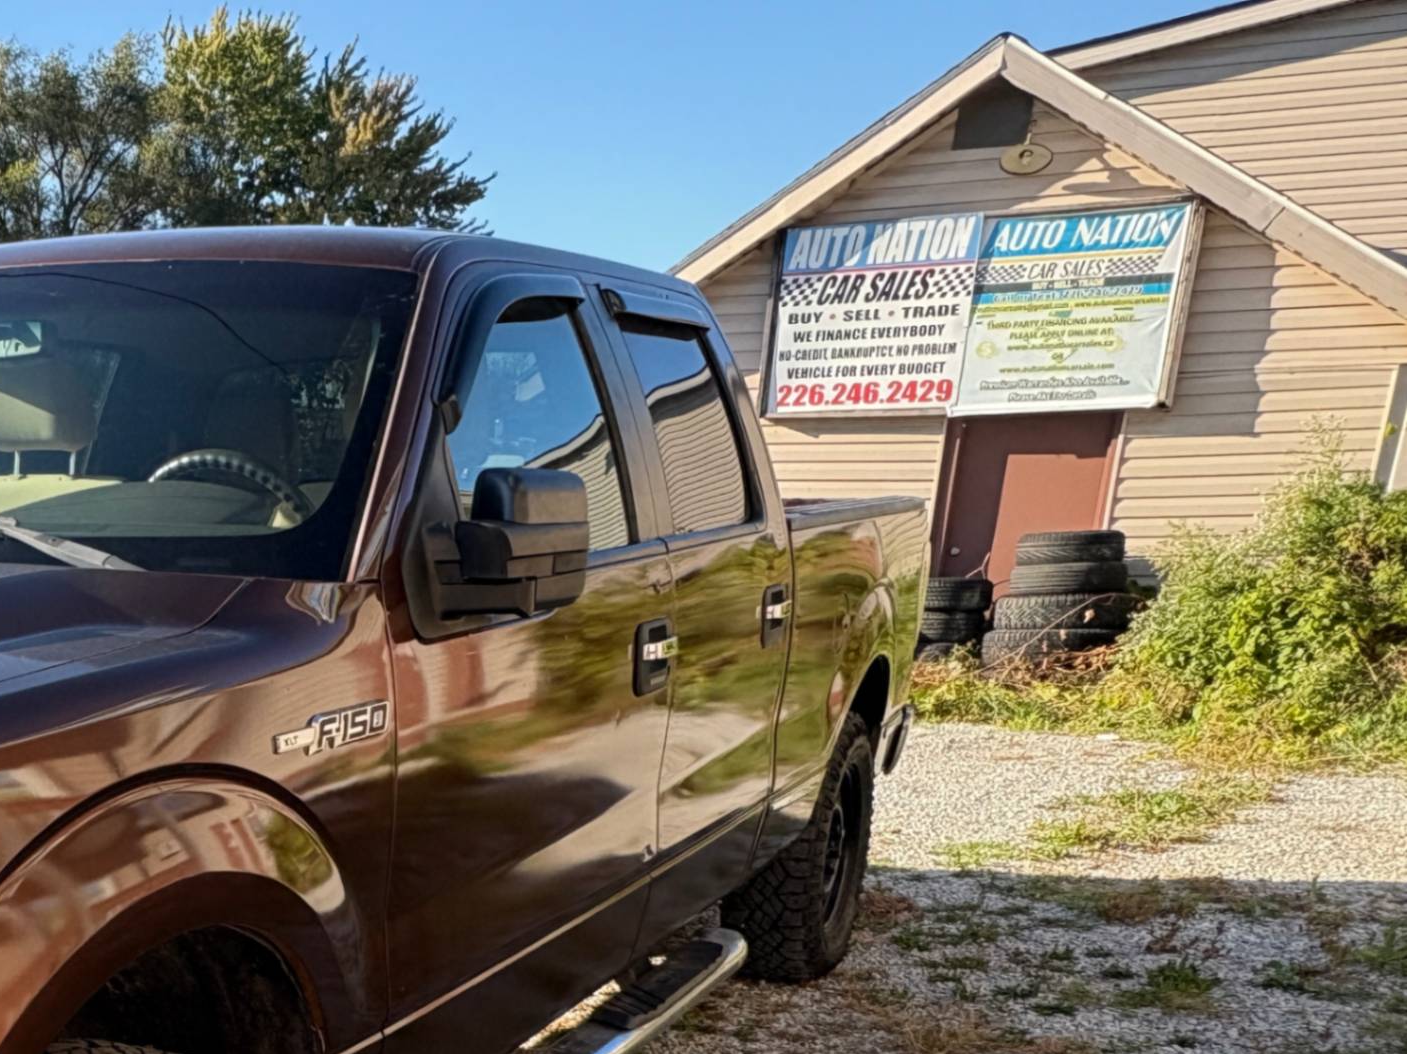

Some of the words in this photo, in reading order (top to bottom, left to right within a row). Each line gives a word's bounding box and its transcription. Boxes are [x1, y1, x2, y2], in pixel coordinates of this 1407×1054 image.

[994, 219, 1067, 252] AUTO
[1071, 211, 1180, 247] NATION
[788, 225, 866, 270] AUTO
[866, 216, 976, 265] NATION
[1027, 262, 1057, 280] CAR
[1060, 259, 1106, 278] SALES
[817, 273, 866, 306] CAR
[864, 269, 936, 303] SALES
[788, 311, 824, 324] BUY
[842, 309, 882, 322] SELL
[902, 304, 960, 319] TRADE
[1013, 318, 1039, 328] PARTY
[793, 331, 812, 343] WE
[815, 328, 867, 341] FINANCE
[870, 324, 946, 339] EVERYBODY
[1009, 330, 1038, 340] PLEASE
[1040, 329, 1066, 338] APPLY
[1068, 328, 1098, 337] ONLINE
[896, 345, 909, 357] NO
[911, 342, 957, 356] PROBLEM
[787, 366, 833, 379] VEHICLE
[835, 365, 857, 377] FOR
[860, 364, 896, 377] EVERY
[898, 361, 946, 375] BUDGET
[777, 378, 954, 407] 226.246.2429
